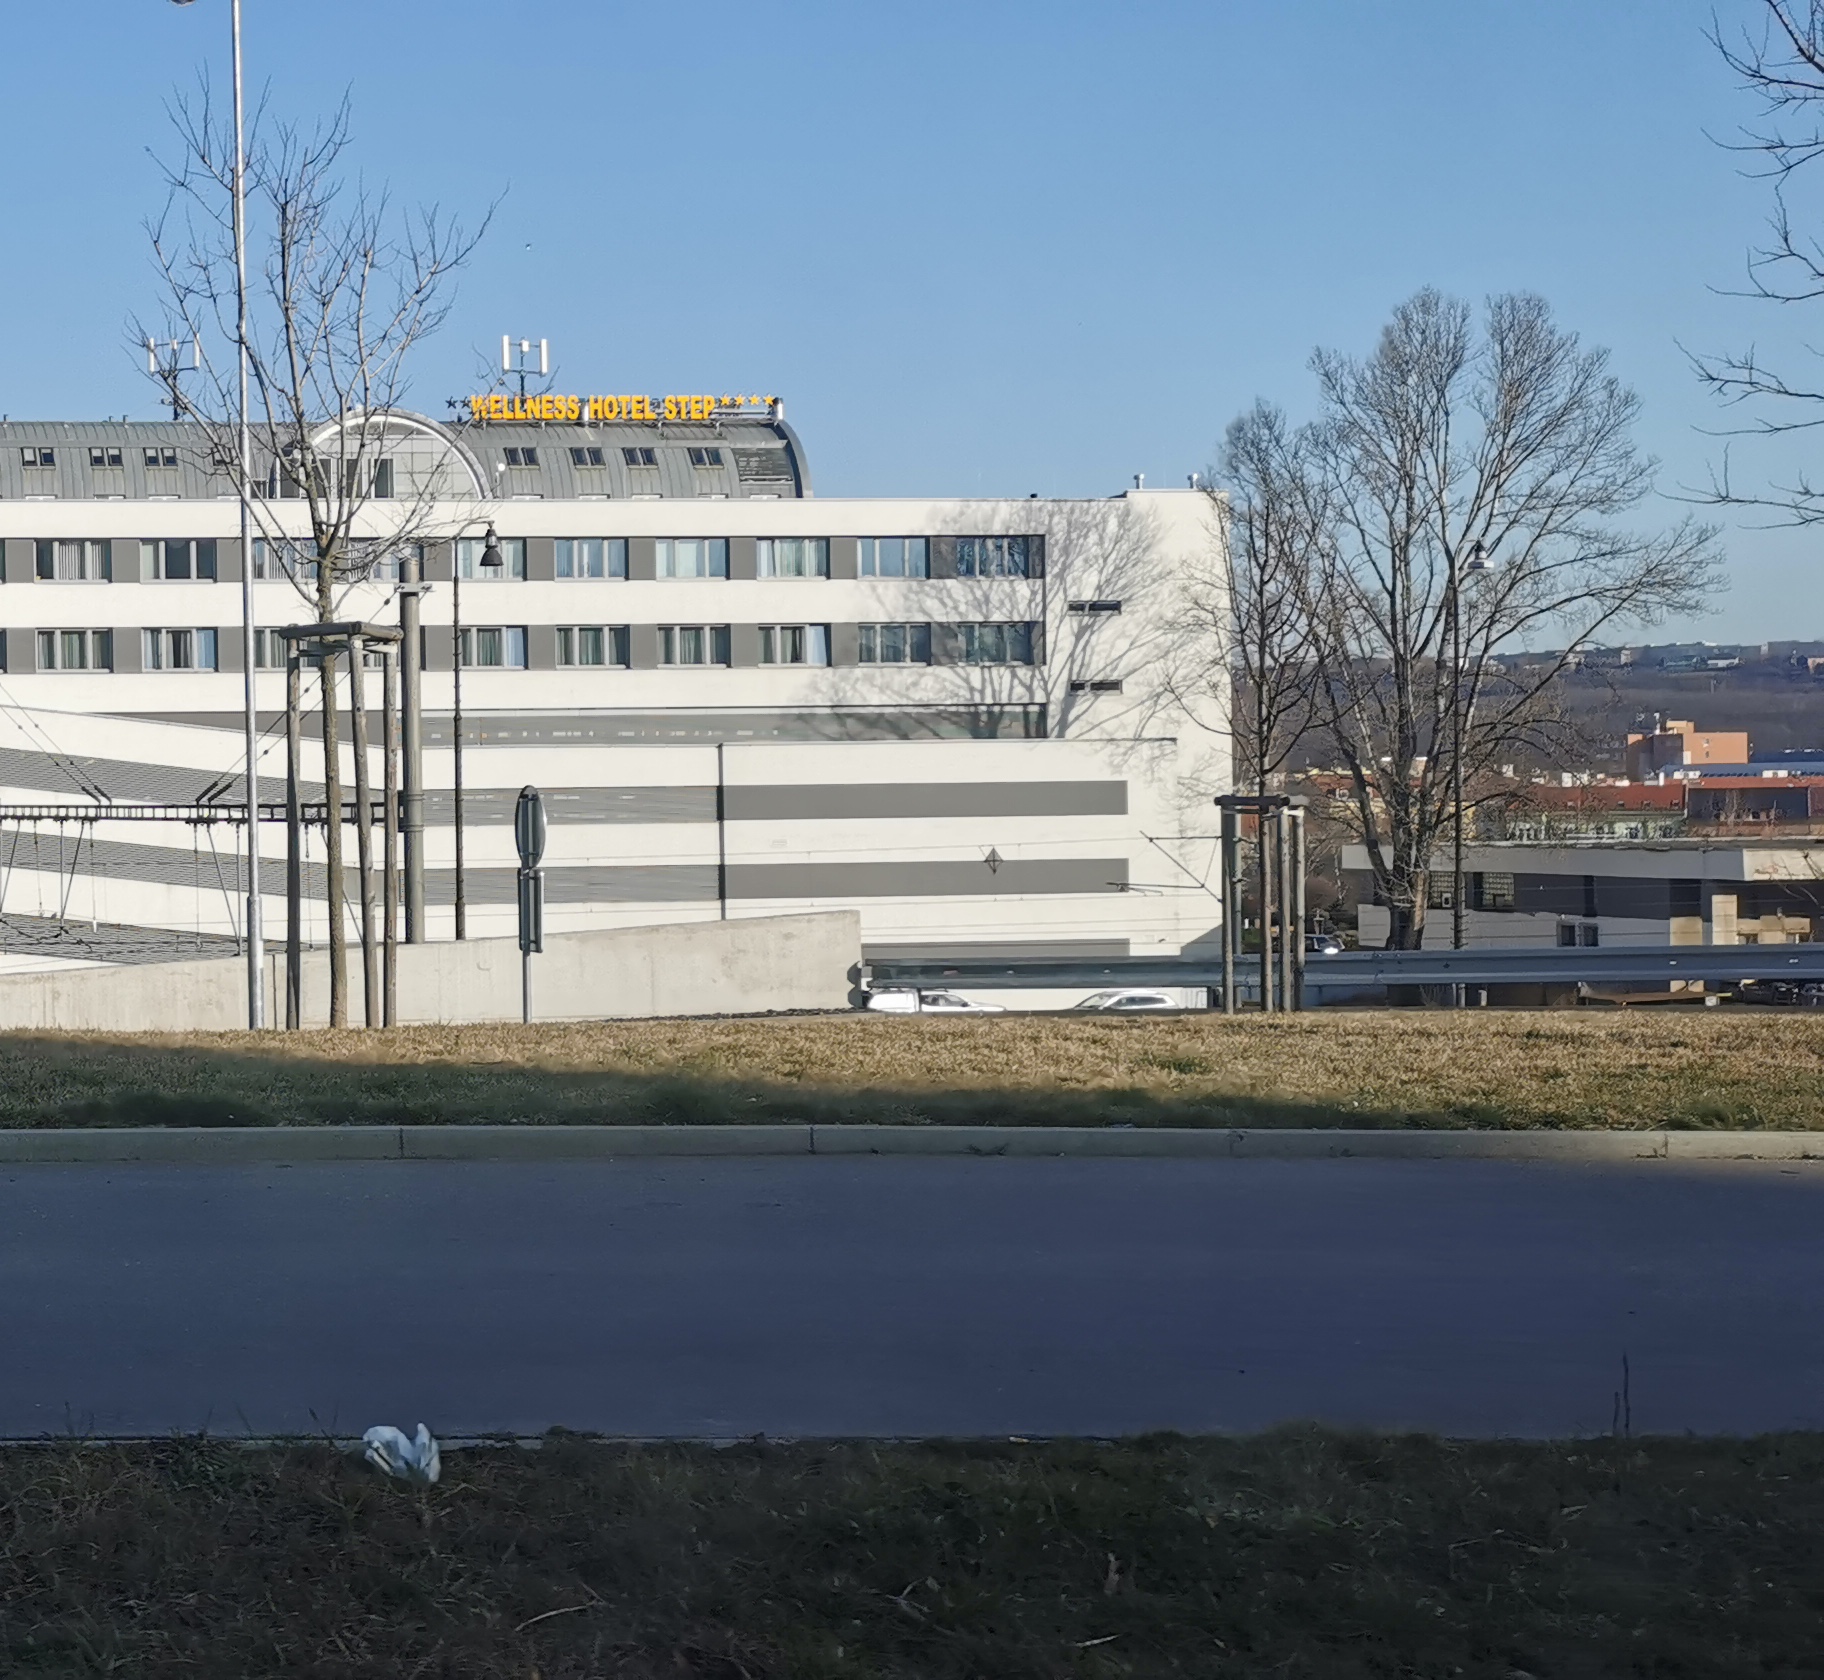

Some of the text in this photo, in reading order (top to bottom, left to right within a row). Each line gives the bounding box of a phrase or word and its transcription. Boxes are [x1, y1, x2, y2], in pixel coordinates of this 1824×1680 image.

[470, 394, 716, 420] WELLNESS HOTEL STEP
